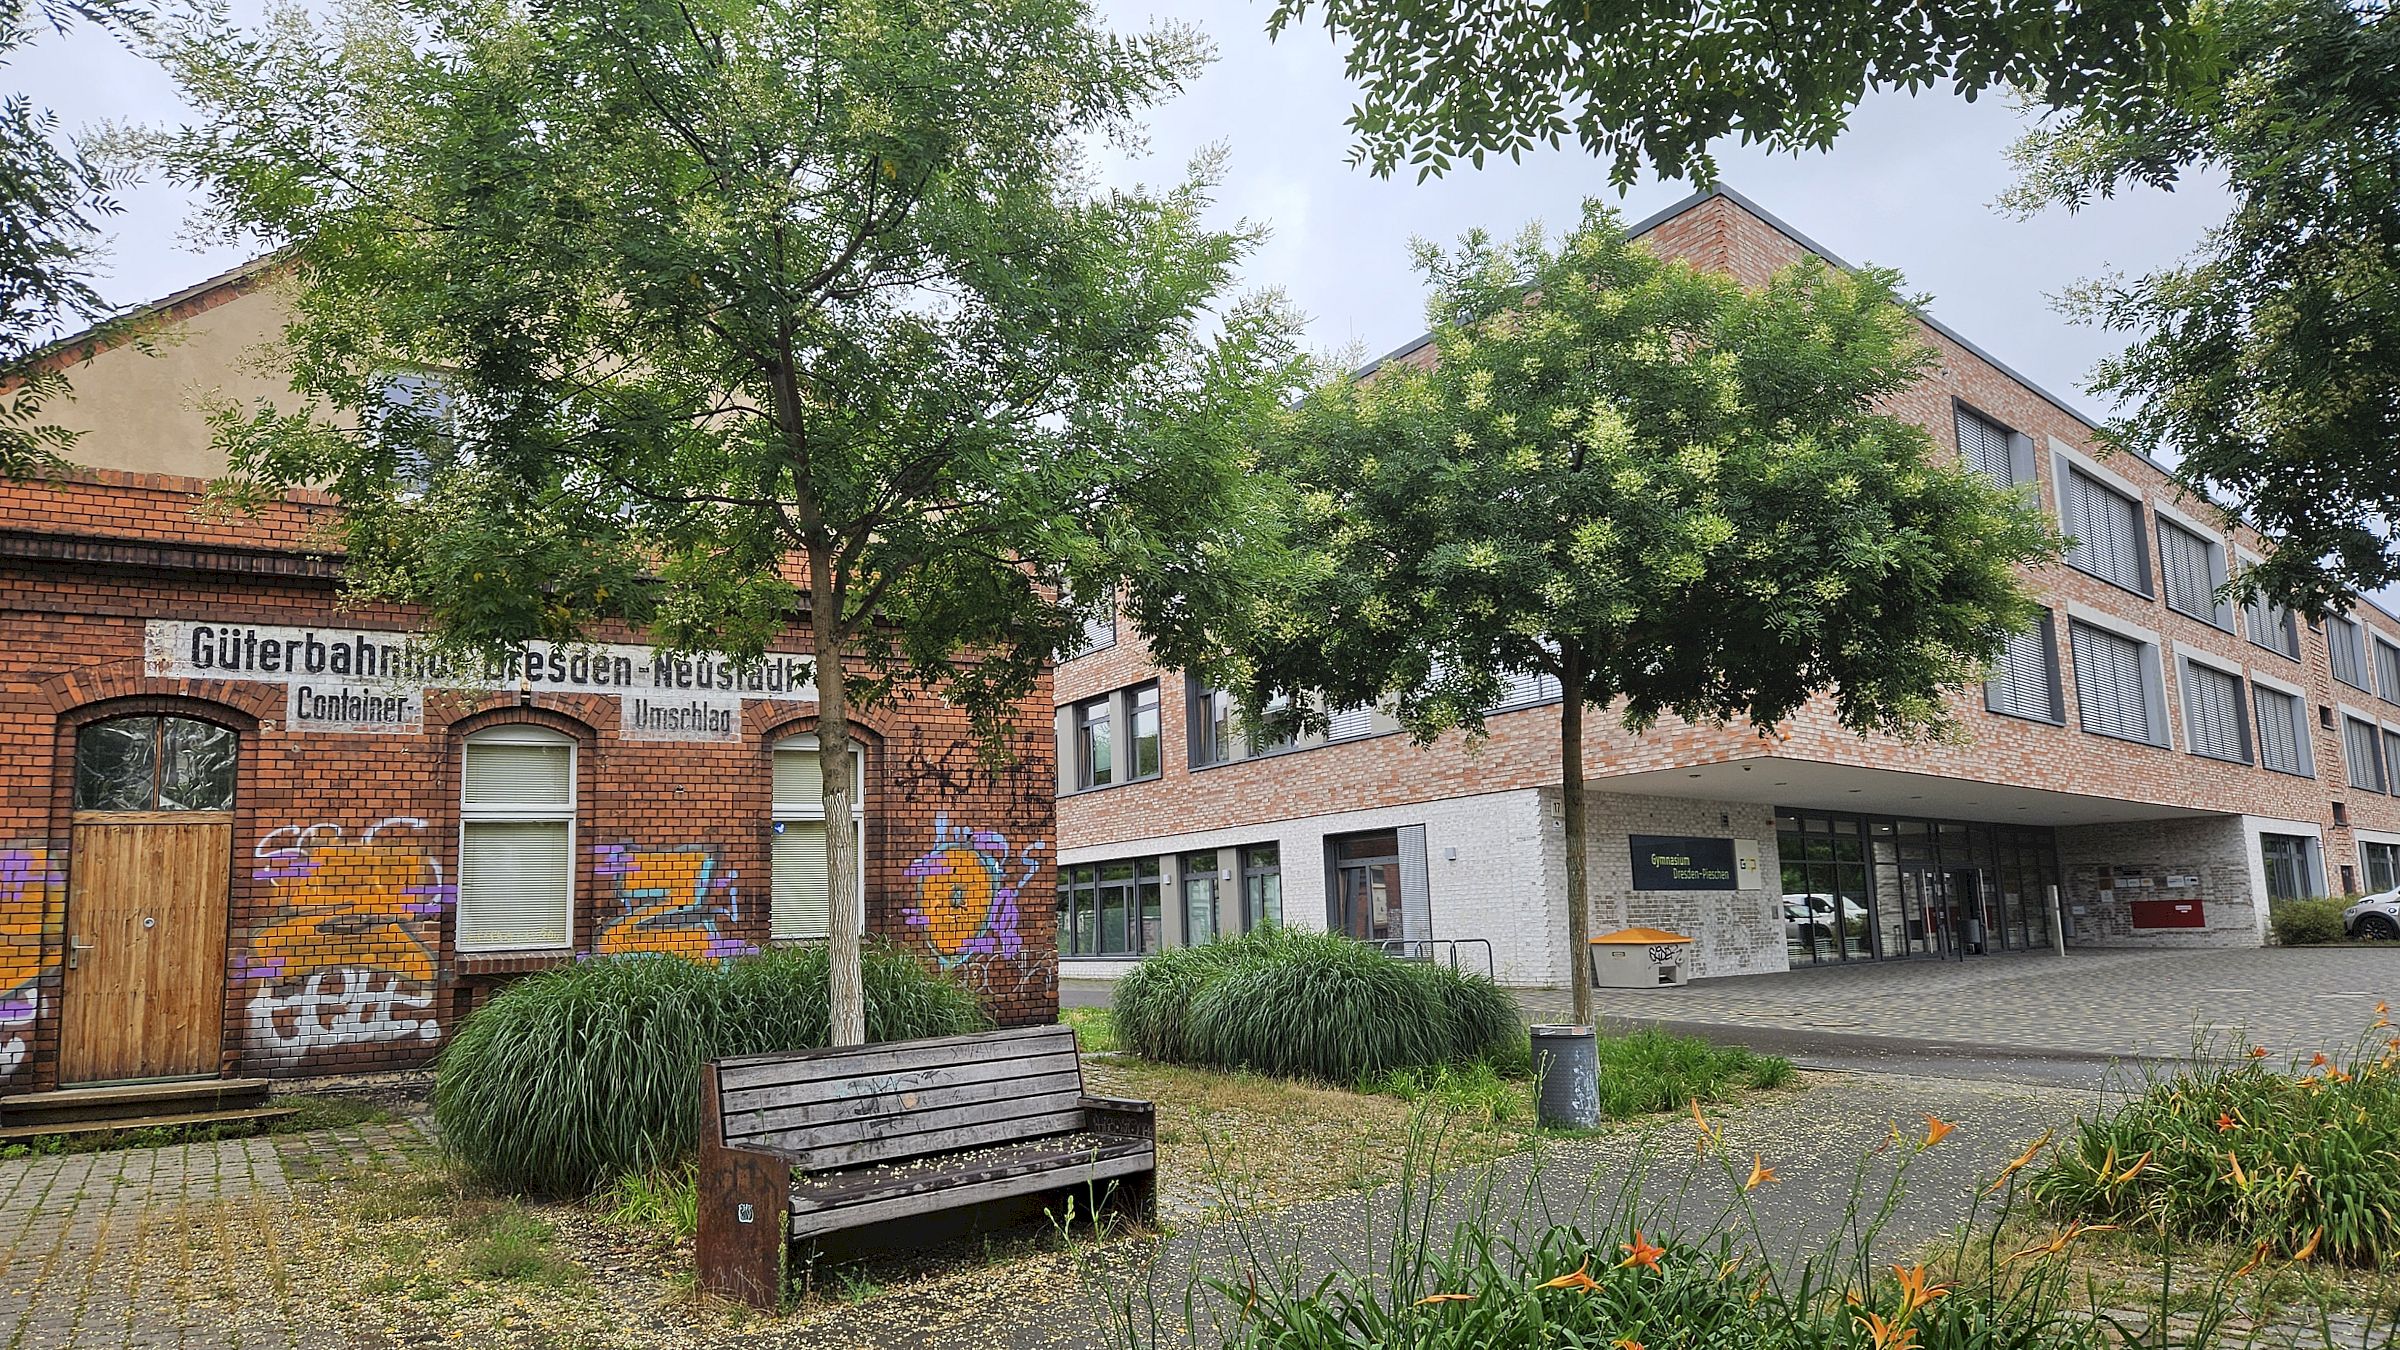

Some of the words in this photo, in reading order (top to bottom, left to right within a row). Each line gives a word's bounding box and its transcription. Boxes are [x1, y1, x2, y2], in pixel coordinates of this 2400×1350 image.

[191, 626, 462, 679] Güterbahnho
[634, 698, 731, 737] Umschlag
[1553, 802, 1561, 814] 17
[1651, 853, 1691, 868] Gymnasium
[1672, 867, 1730, 880] Dresden-Pieschen
